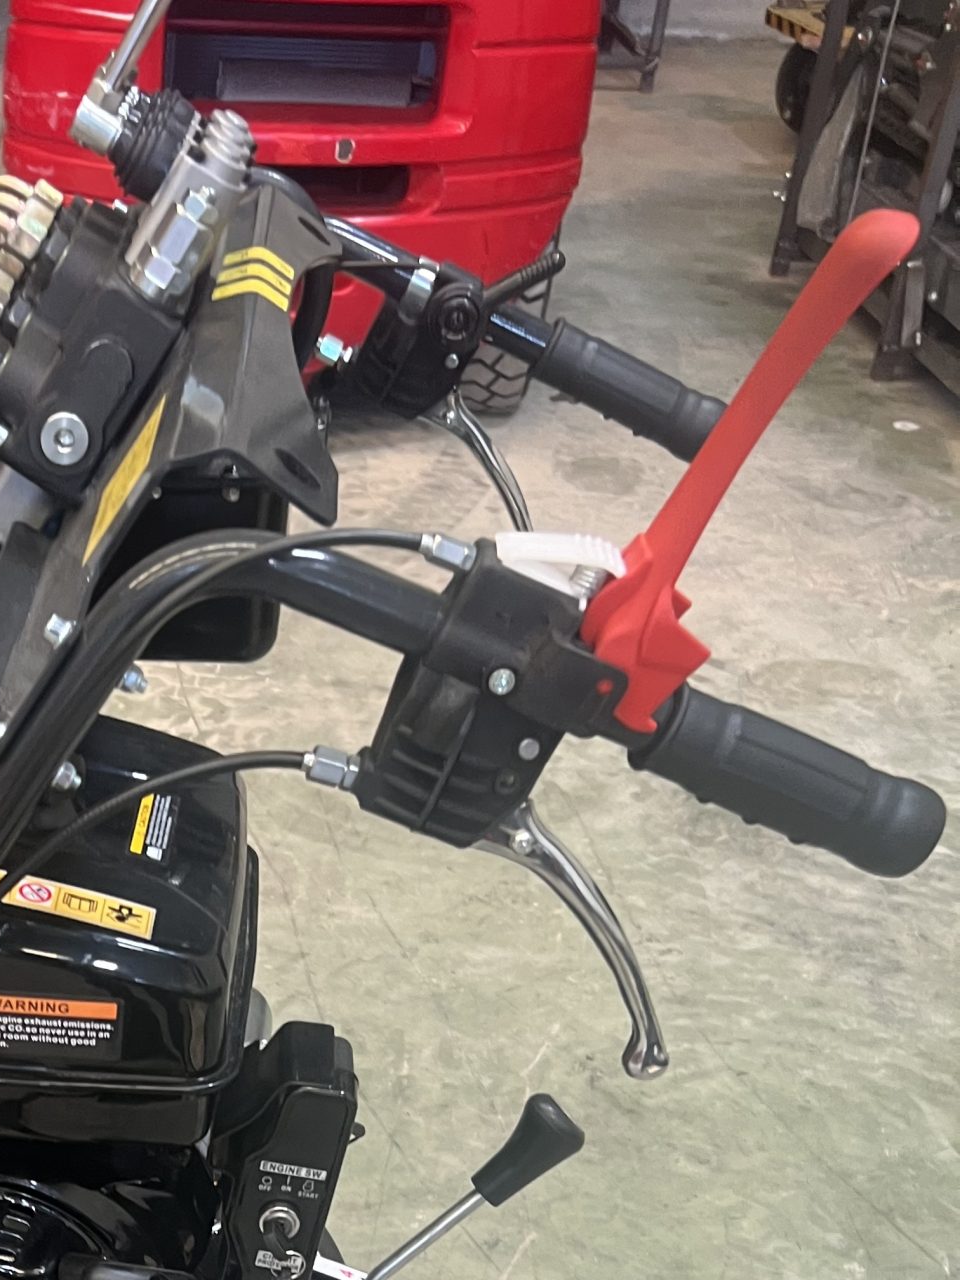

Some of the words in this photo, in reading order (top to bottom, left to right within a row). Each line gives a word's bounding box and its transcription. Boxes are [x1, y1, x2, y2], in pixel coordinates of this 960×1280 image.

[24, 1017, 61, 1028] exhaust
[39, 1027, 66, 1036] never
[68, 1029, 85, 1037] use
[87, 1030, 97, 1038] in
[98, 1031, 110, 1039] an
[3, 1032, 29, 1041] room
[31, 1035, 68, 1045] without
[70, 1038, 96, 1046] good
[262, 1161, 301, 1176] ENGINE
[281, 1184, 292, 1192] ON
[298, 1190, 319, 1199] START
